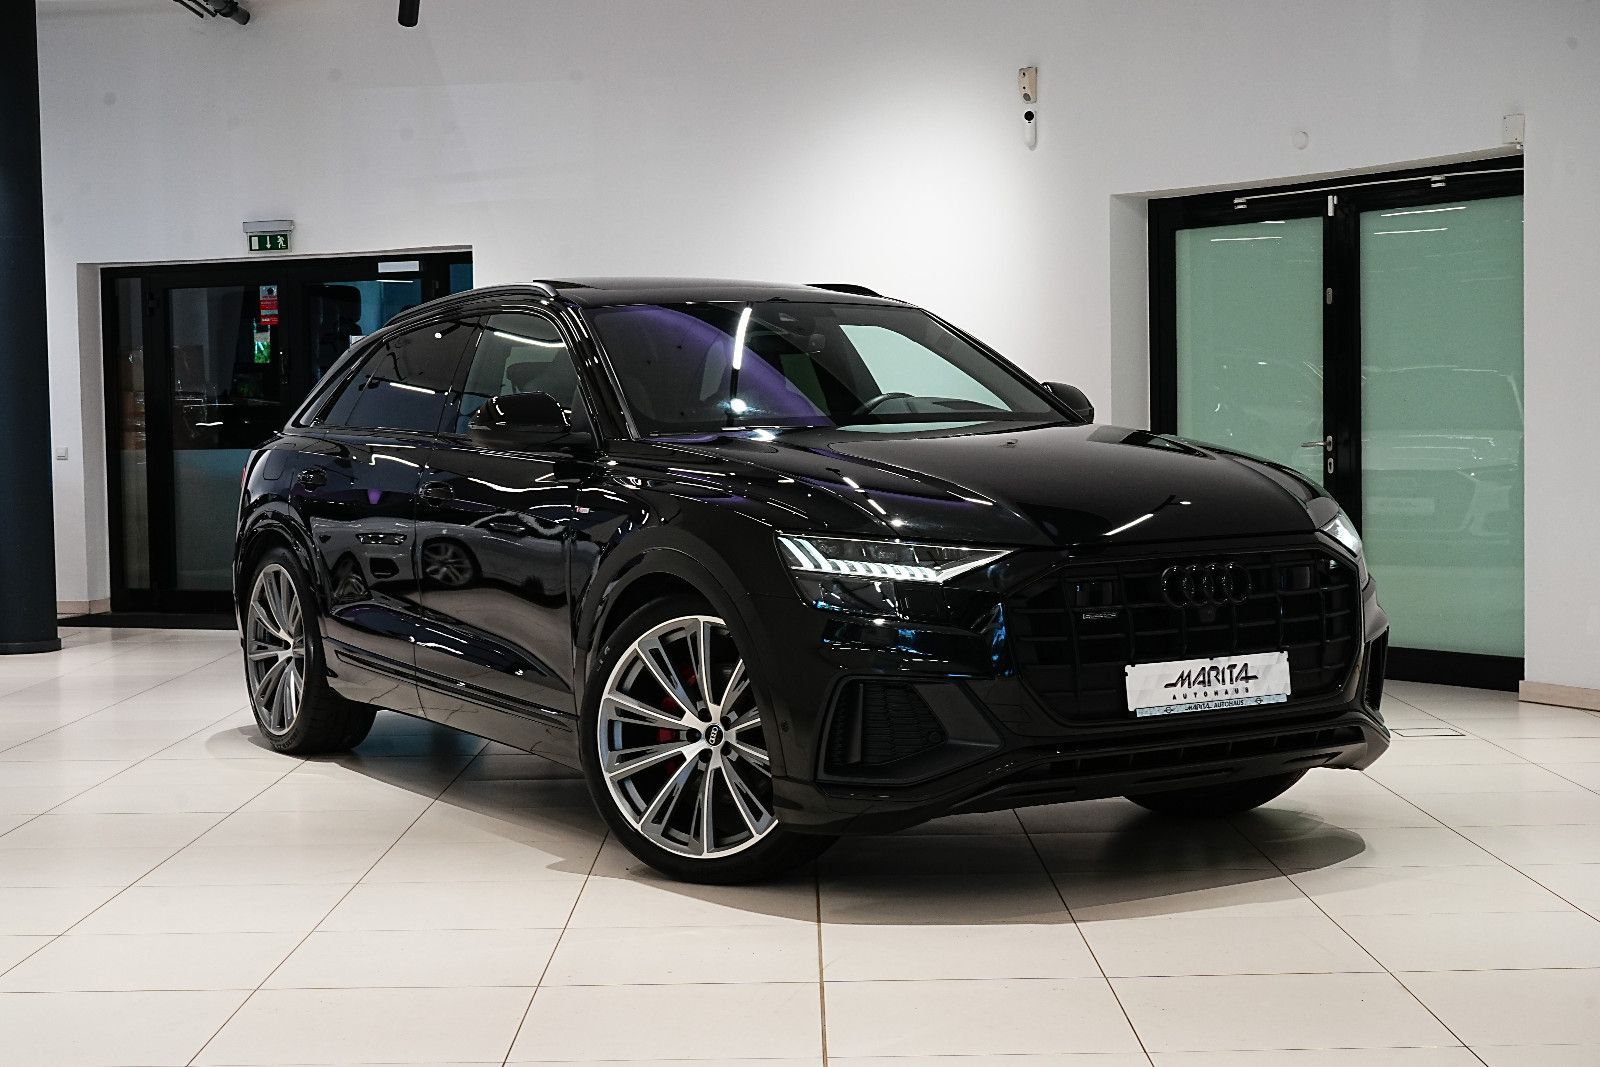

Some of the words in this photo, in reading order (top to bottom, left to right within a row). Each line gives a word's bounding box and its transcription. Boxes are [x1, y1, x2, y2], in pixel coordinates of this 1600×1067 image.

[1164, 662, 1258, 688] MARITA
[1172, 687, 1249, 700] AUTOHAUS
[1213, 699, 1244, 708] AUTOHAUS
